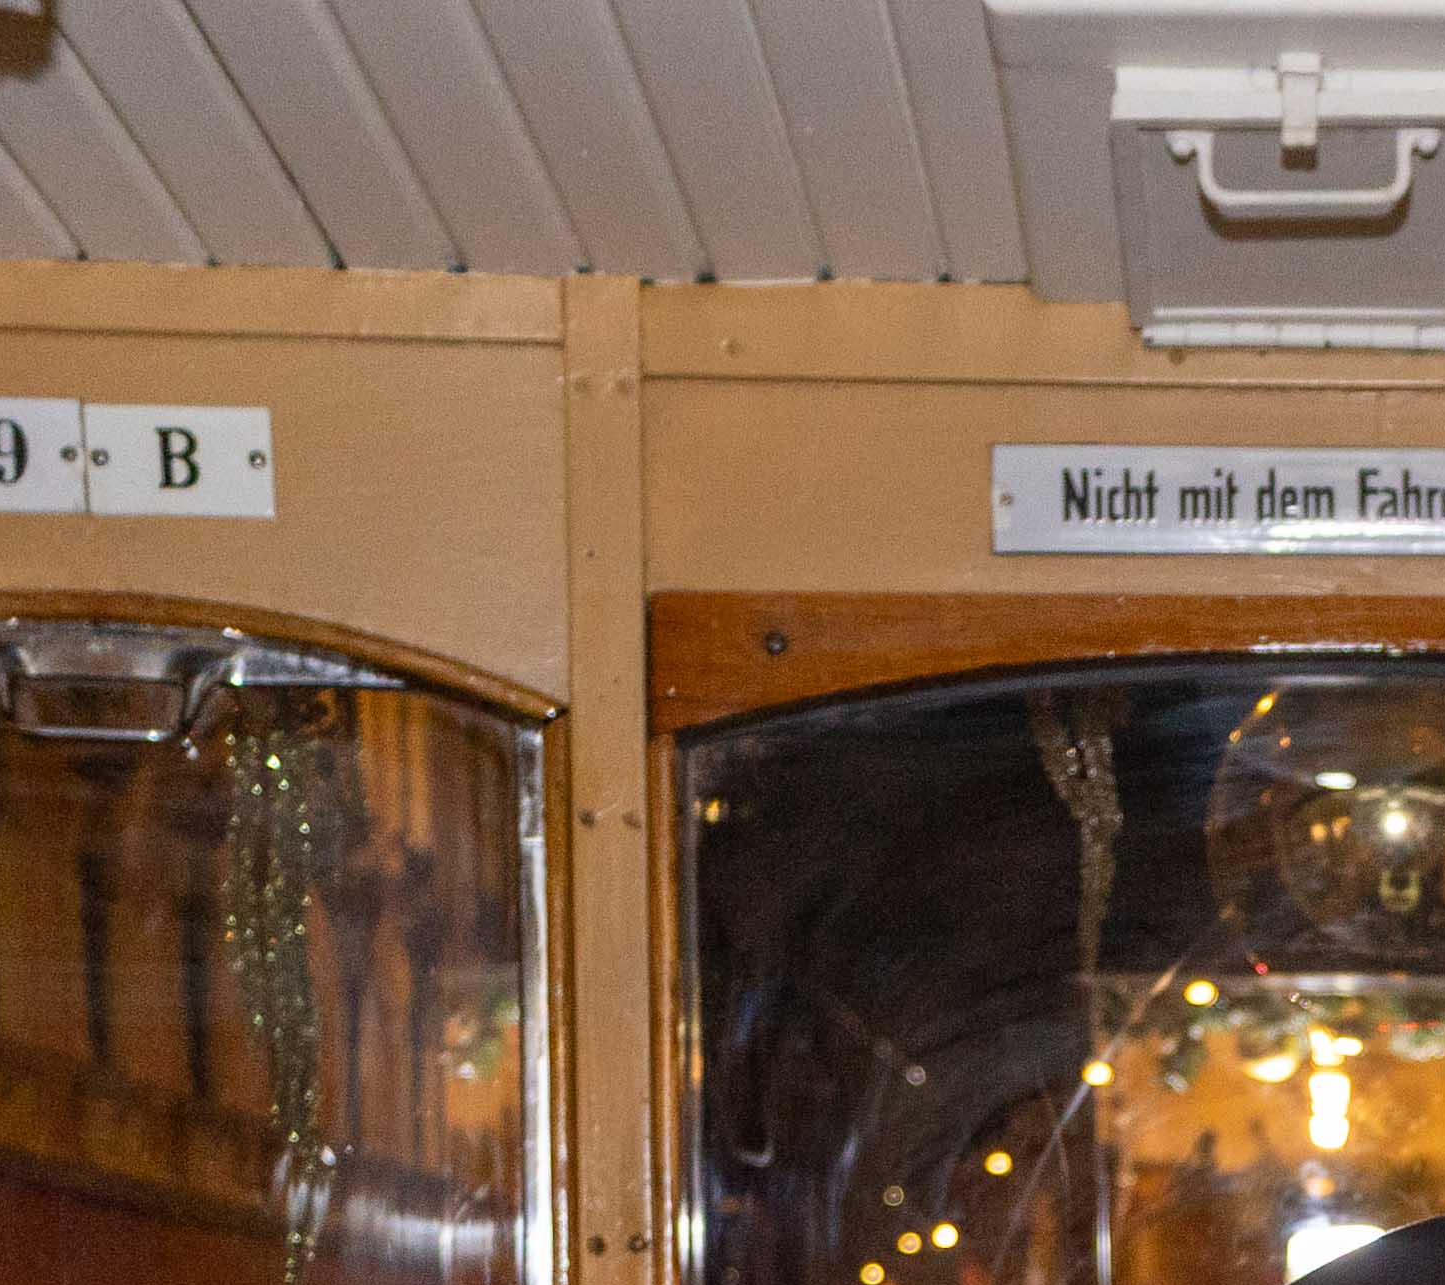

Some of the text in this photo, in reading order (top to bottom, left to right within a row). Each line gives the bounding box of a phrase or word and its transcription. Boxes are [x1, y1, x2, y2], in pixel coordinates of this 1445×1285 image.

[154, 426, 202, 490] B
[1061, 469, 1157, 525] Nicht
[1179, 469, 1238, 524] mit
[1255, 470, 1335, 523] dem
